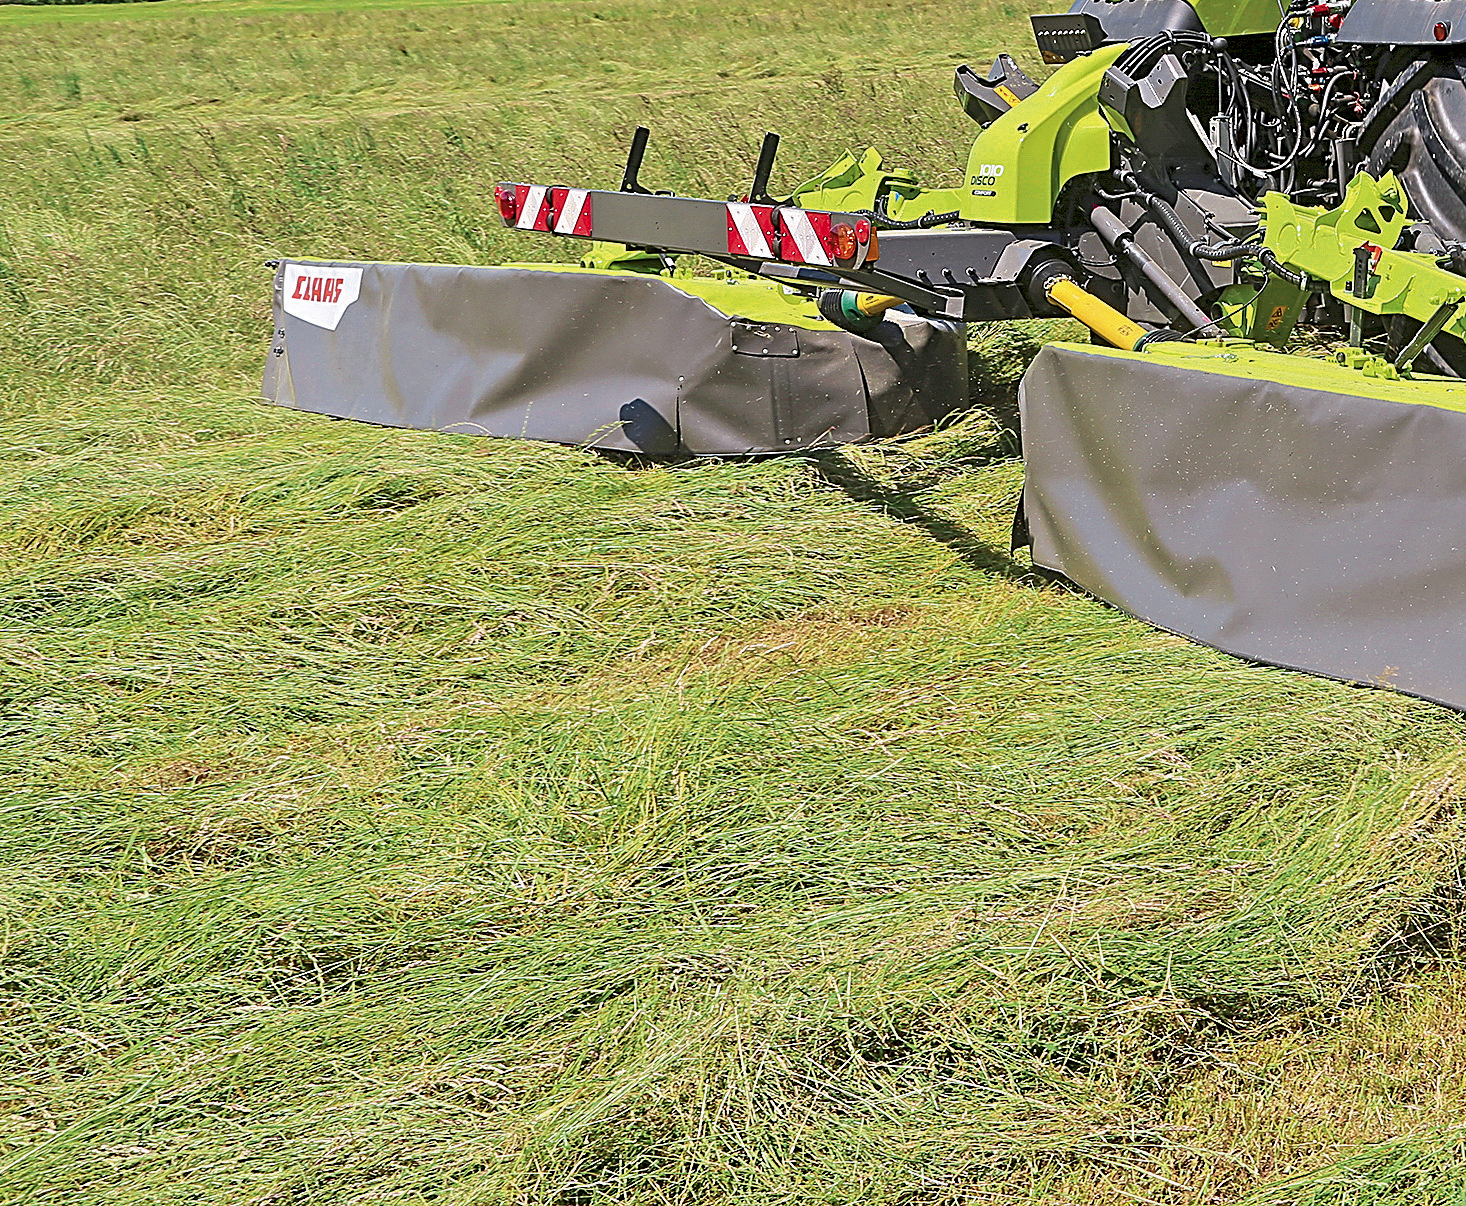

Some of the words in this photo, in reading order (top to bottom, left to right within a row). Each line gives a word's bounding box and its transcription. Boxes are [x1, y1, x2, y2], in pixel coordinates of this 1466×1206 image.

[979, 164, 1004, 177] 1010
[970, 175, 996, 186] DISCO
[291, 276, 344, 303] CLAAS
